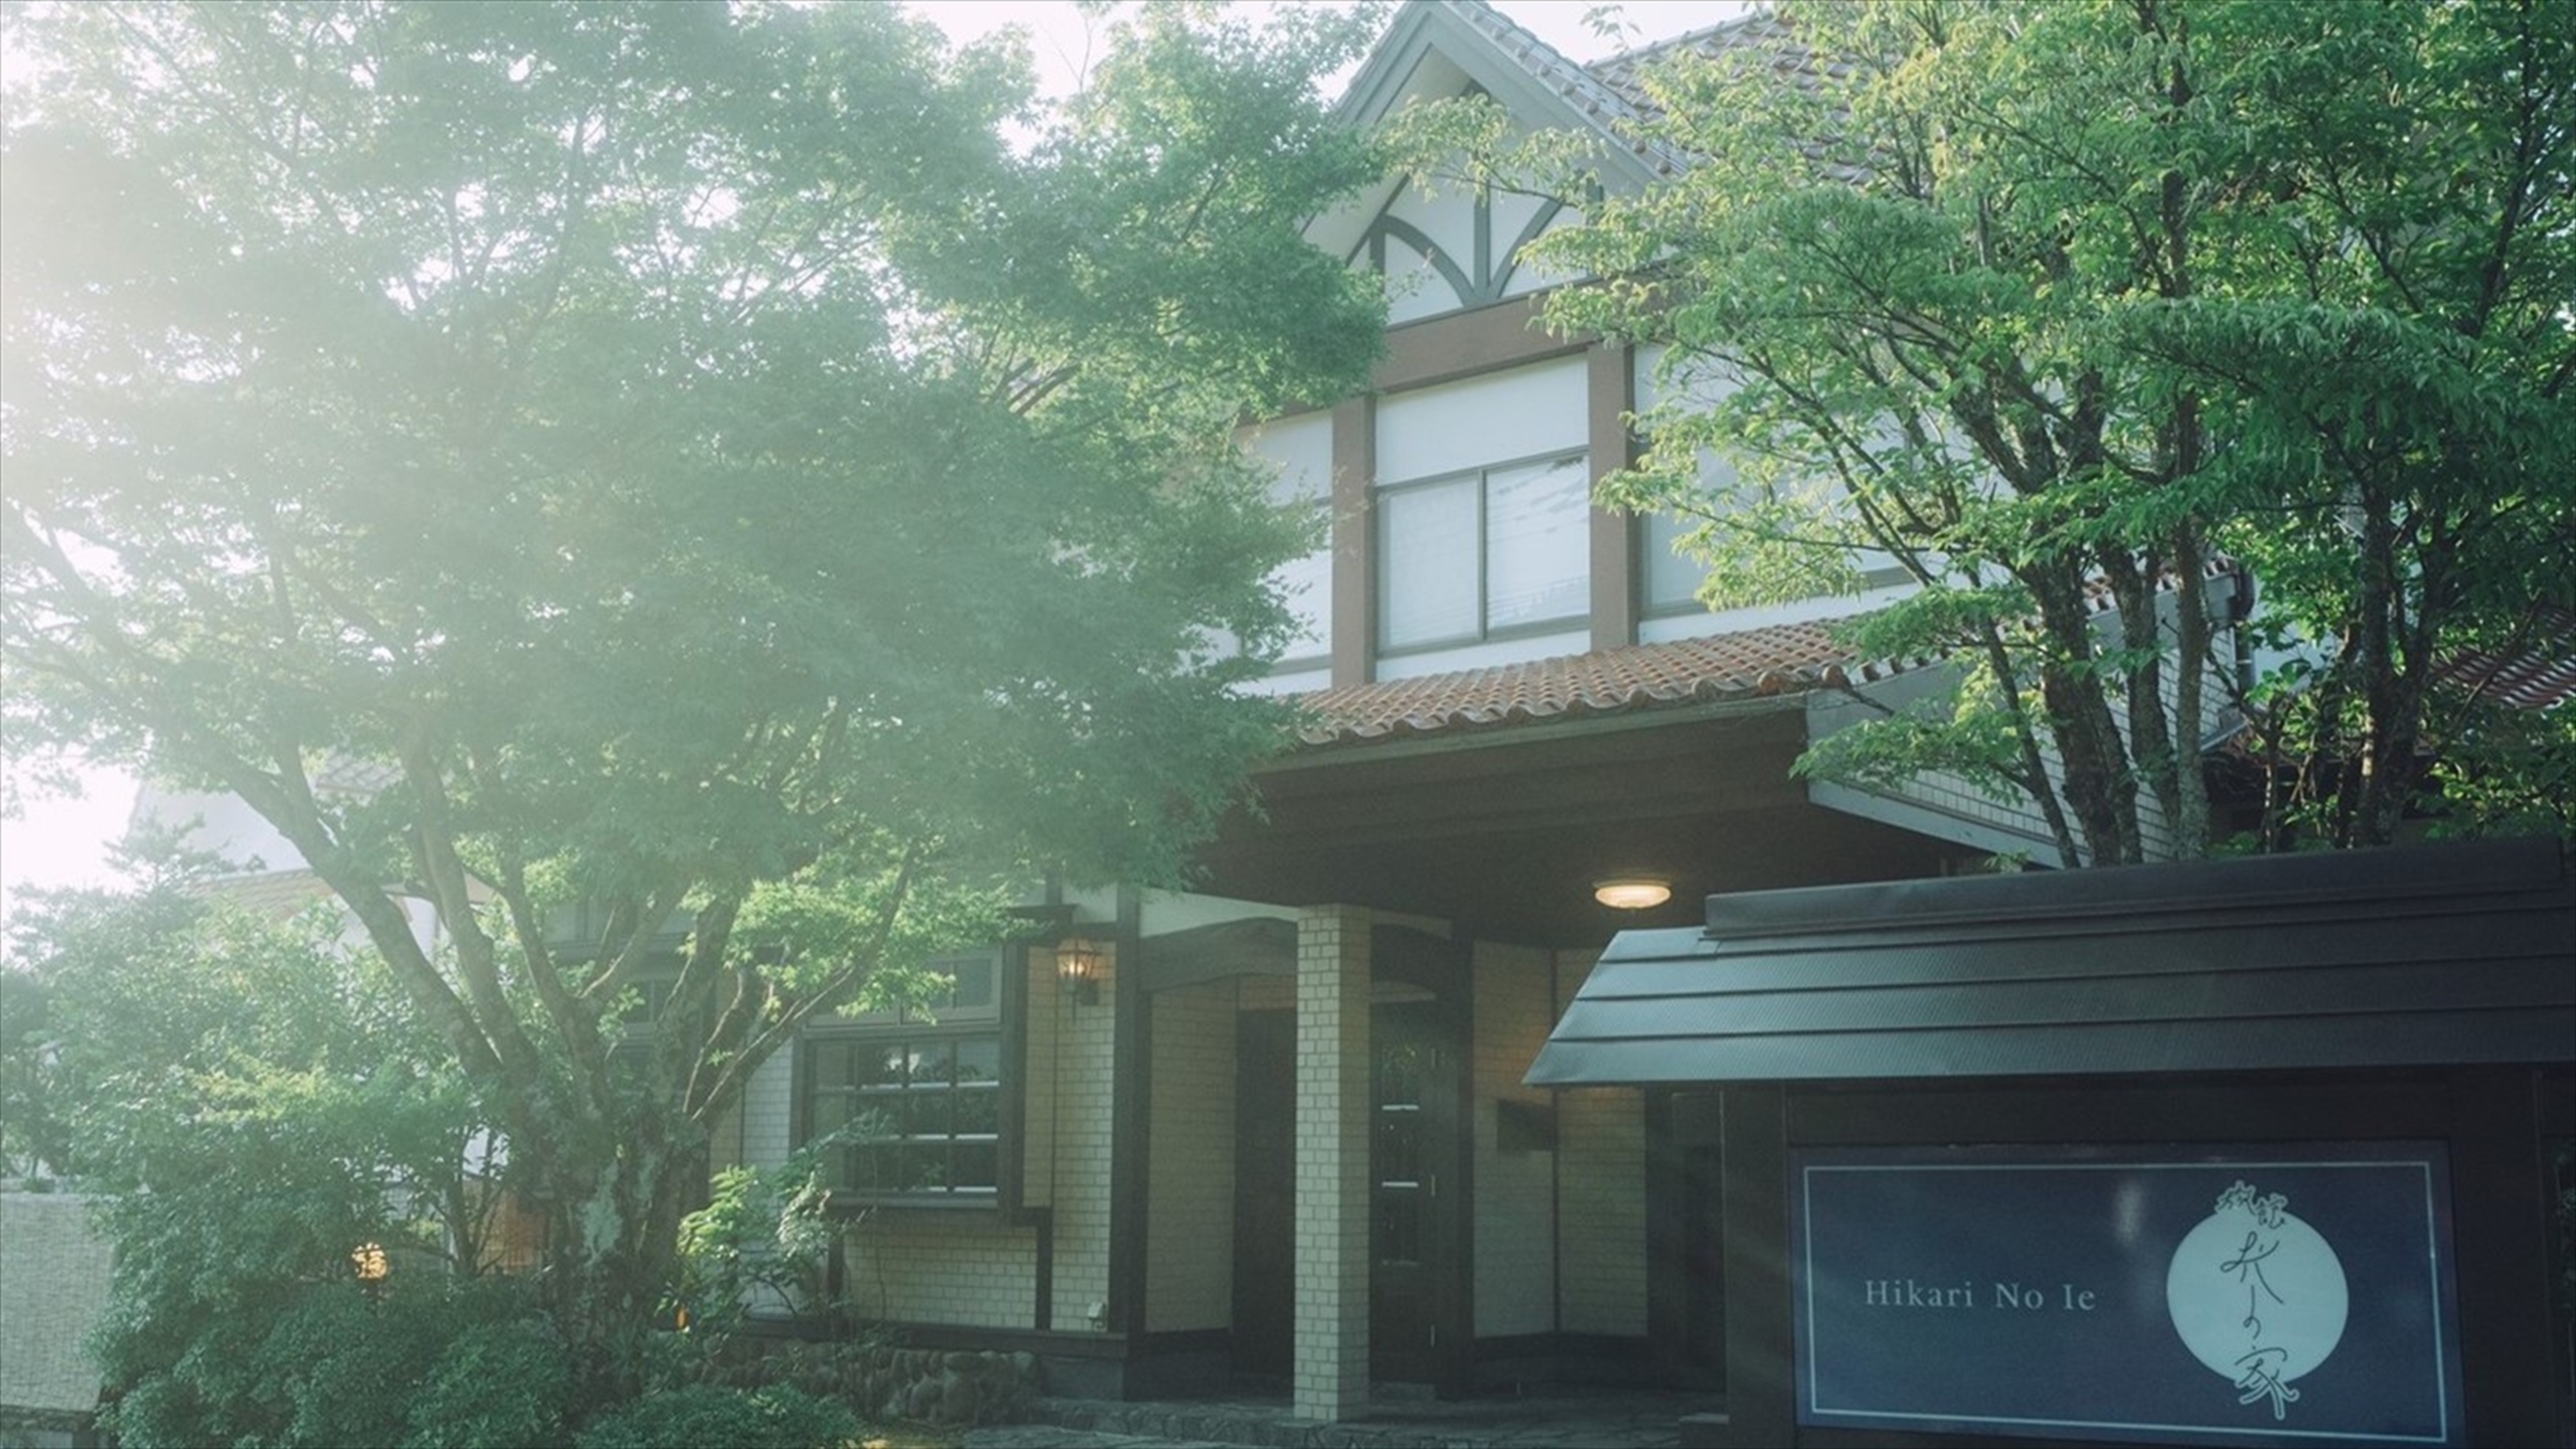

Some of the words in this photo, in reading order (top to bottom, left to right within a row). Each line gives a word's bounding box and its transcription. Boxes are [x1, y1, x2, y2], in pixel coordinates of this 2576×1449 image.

[1865, 1279, 1972, 1308] Hikari
[1996, 1282, 2043, 1310] No
[2062, 1283, 2096, 1310] Ie
